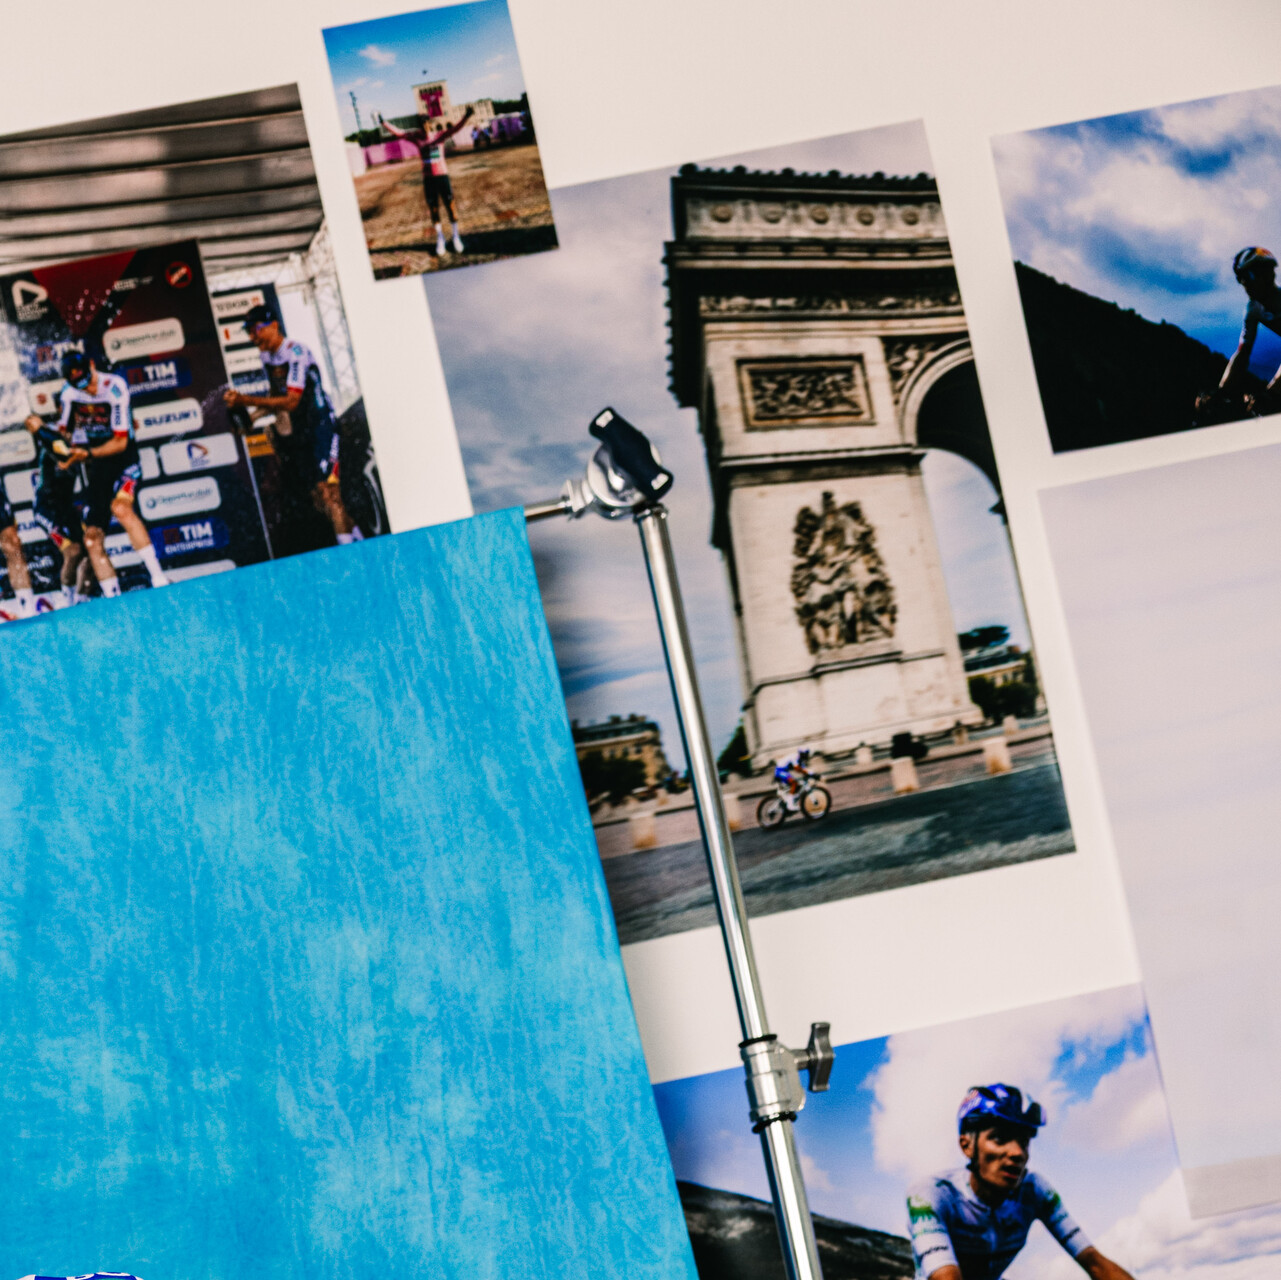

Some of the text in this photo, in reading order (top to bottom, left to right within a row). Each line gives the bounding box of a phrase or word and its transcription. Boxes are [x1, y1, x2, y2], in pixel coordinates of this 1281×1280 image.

[143, 361, 178, 381] TIM
[143, 410, 198, 427] SUZUKI
[179, 521, 214, 541] TIM
